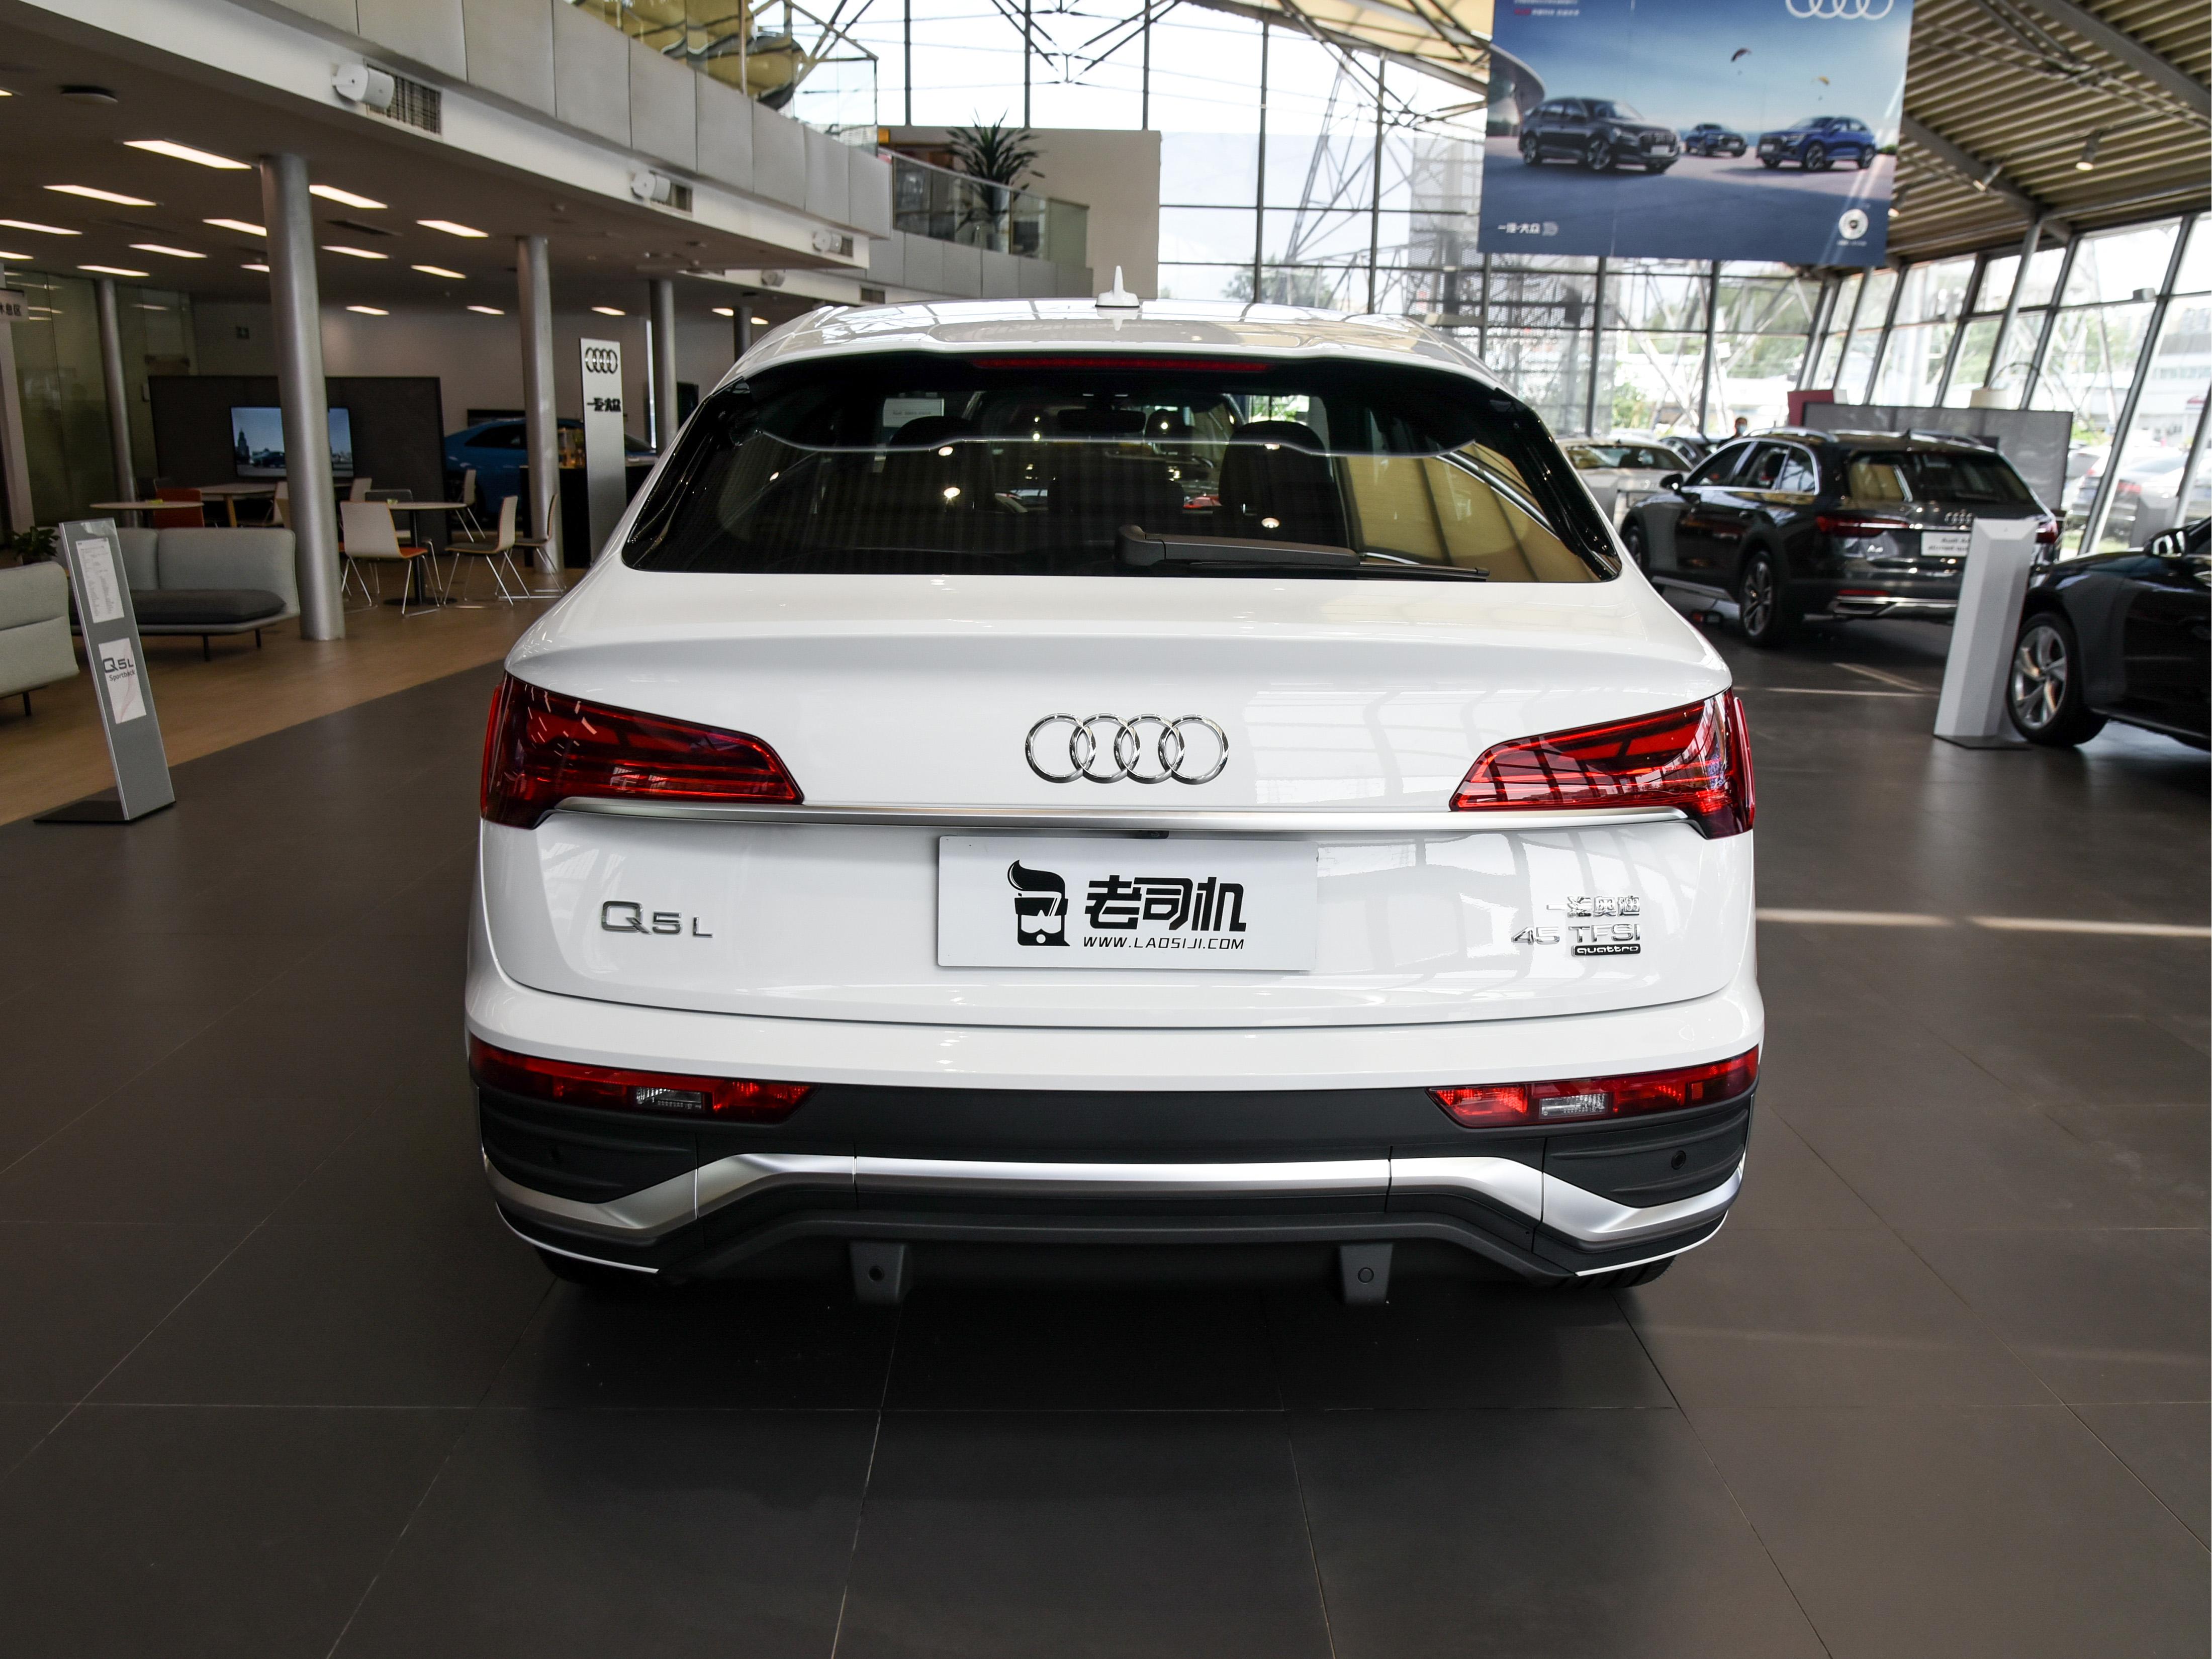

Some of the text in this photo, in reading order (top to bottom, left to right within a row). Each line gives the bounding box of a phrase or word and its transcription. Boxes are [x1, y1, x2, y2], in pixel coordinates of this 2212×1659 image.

[103, 658, 134, 674] Q5L
[109, 670, 136, 682] Sportback
[1084, 874, 1247, 932] 老司机
[1546, 895, 1640, 918] 一汽奥迪
[1511, 923, 1641, 946] 45 TFSI
[1083, 936, 1245, 950] WWW.LAOSIJI.COM
[1576, 945, 1639, 955] quattro
